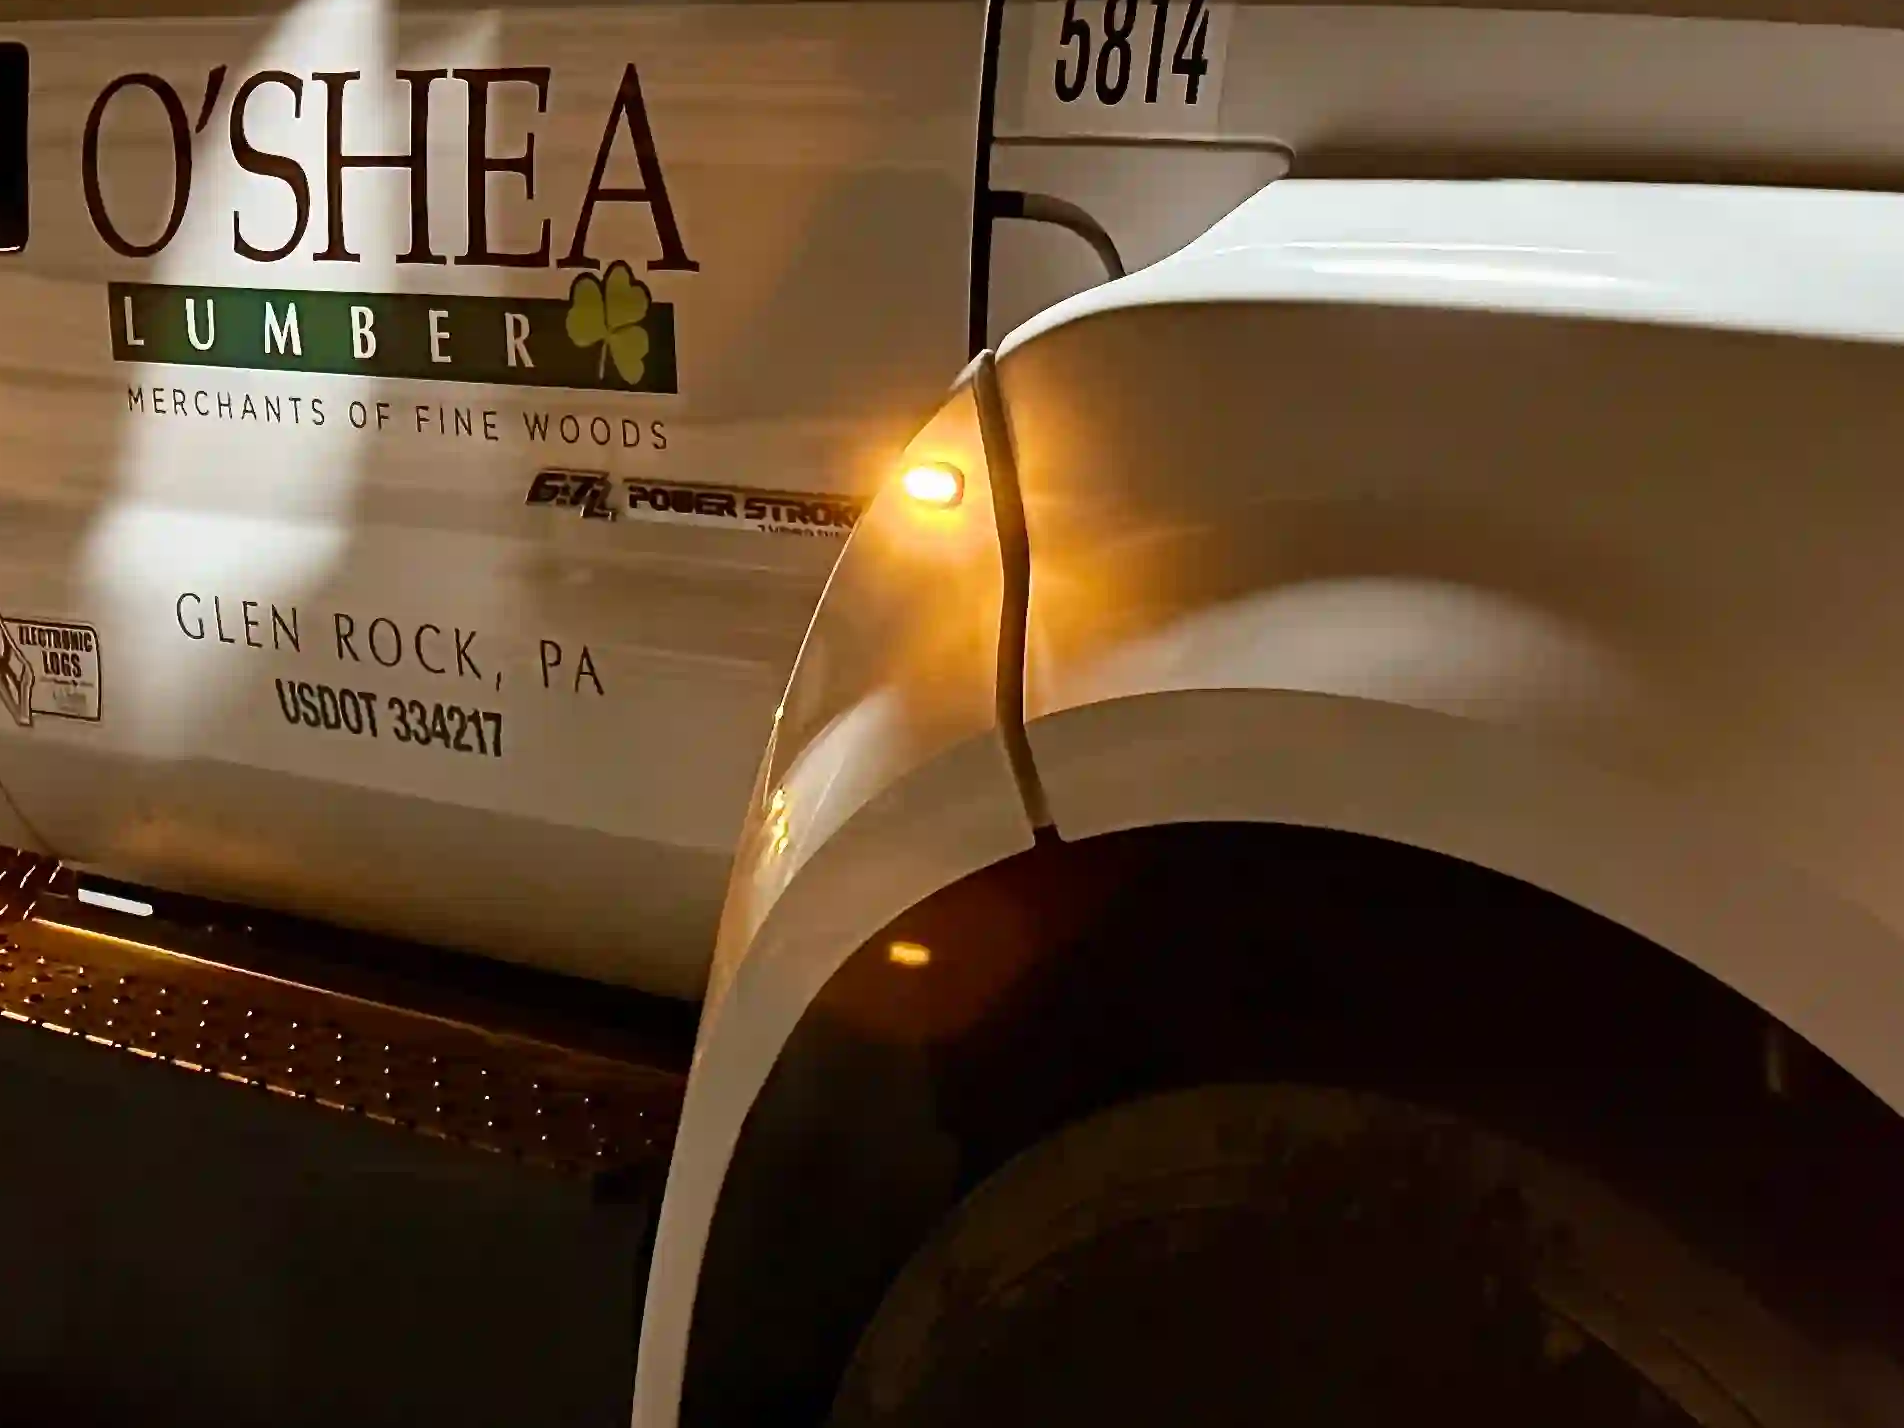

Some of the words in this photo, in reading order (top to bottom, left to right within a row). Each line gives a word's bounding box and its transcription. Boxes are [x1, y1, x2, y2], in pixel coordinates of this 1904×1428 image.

[81, 62, 700, 273] O'SHEA
[123, 295, 535, 368] LUMBER
[126, 386, 326, 426] MERCHANTS
[348, 400, 391, 430] OF
[415, 404, 500, 442] FINE
[524, 413, 668, 451] WOODS
[628, 484, 738, 519] POWER
[744, 496, 862, 529] STROK
[41, 650, 82, 678] LOGS
[176, 592, 301, 653] GLEN
[333, 612, 501, 692] ROCK,
[539, 638, 605, 696] PA
[274, 678, 378, 738] USDOT
[387, 697, 503, 757] 334217
